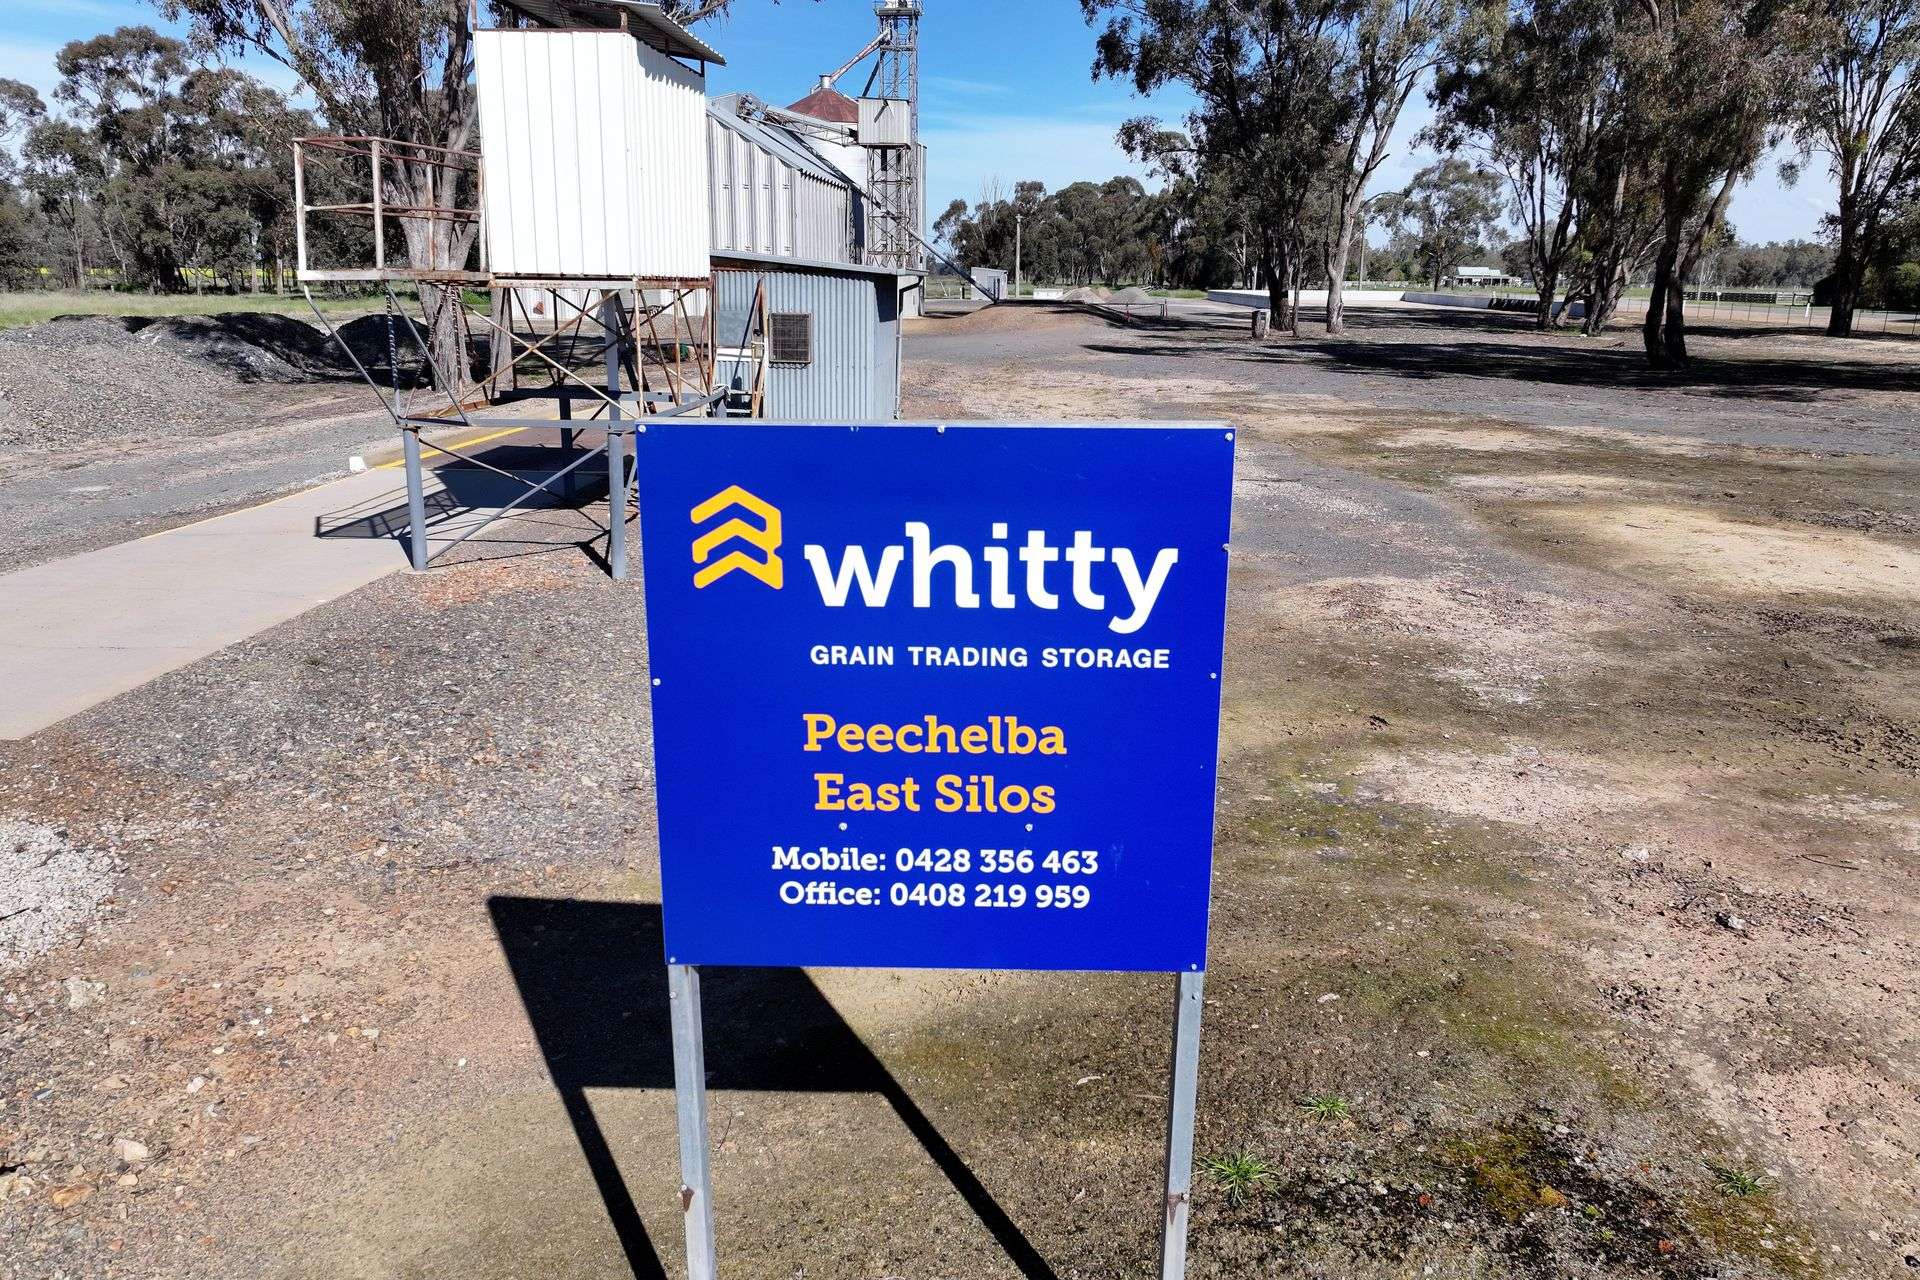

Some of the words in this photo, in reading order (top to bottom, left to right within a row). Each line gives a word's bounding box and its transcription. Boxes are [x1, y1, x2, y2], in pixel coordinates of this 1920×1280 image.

[803, 521, 1179, 634] whitty
[810, 645, 894, 666] GRAIN
[907, 646, 1028, 668] TRADING
[1041, 647, 1170, 669] STORAGE
[802, 713, 1068, 755] Peechelba
[813, 772, 921, 812] East
[935, 774, 1056, 814] Silos
[771, 846, 887, 872] Mobile:
[895, 847, 971, 873] 0428
[979, 849, 1035, 874] 356
[1041, 850, 1099, 875] 463
[779, 880, 881, 906] Office:
[890, 882, 966, 907] 0408
[974, 883, 1027, 908] 219
[1035, 884, 1091, 909] 959
